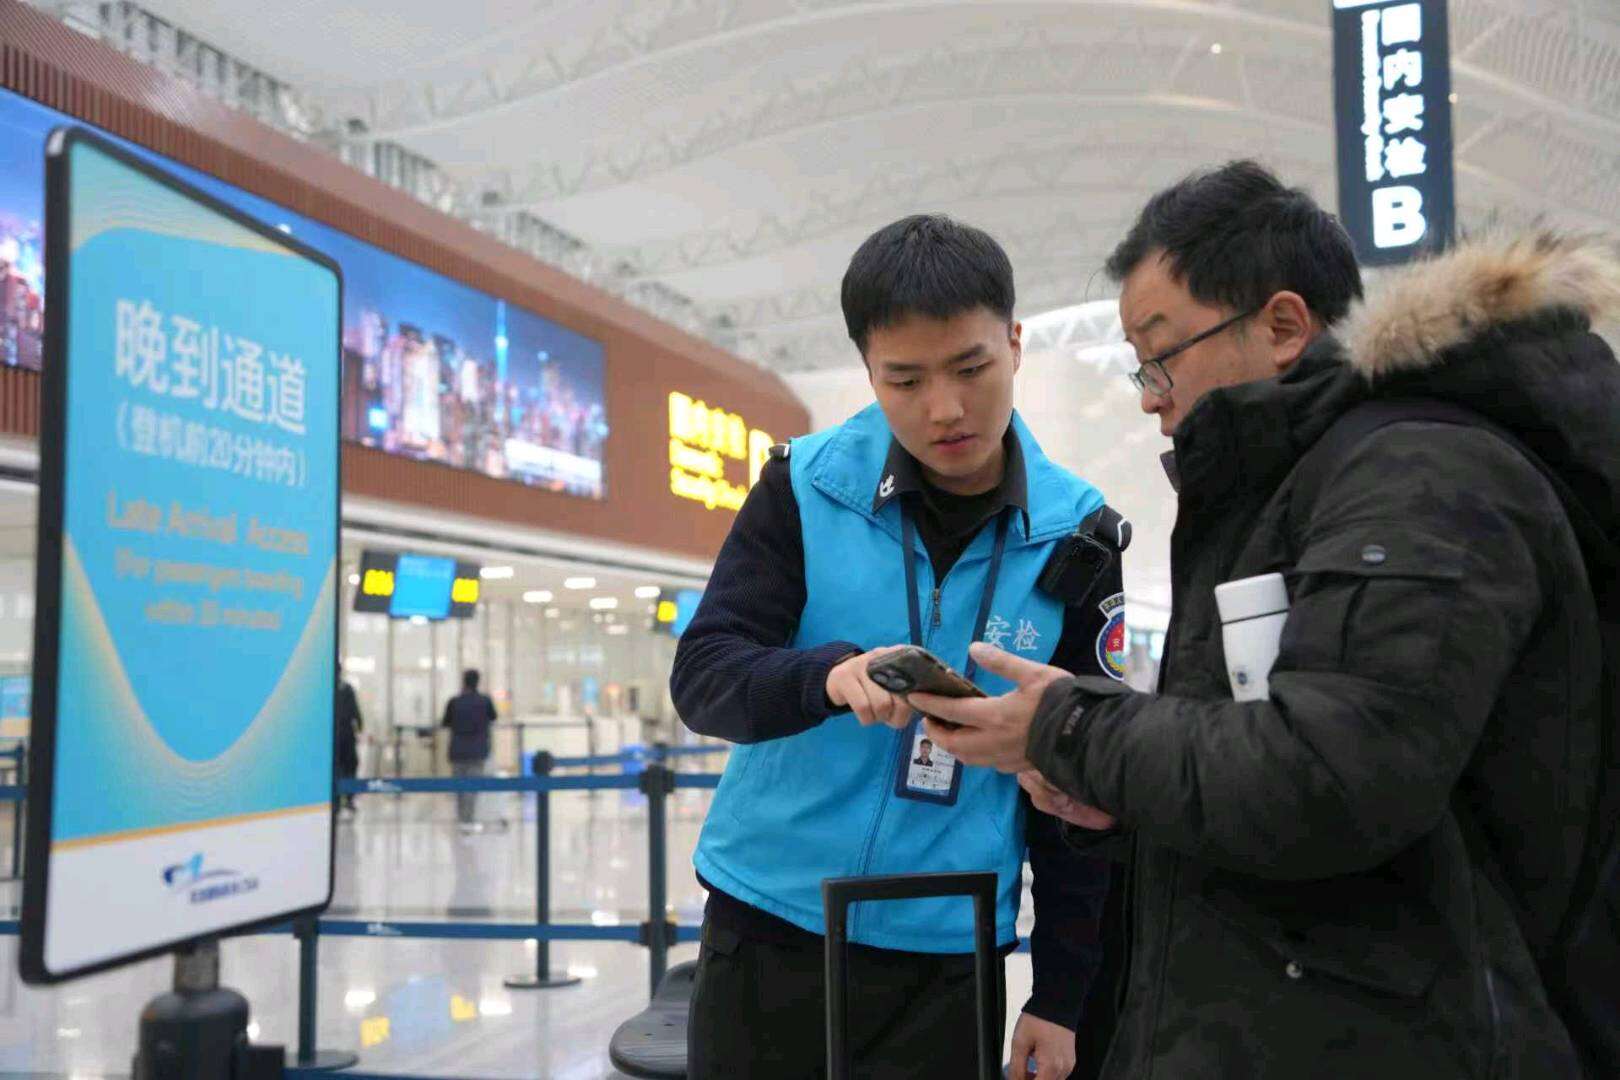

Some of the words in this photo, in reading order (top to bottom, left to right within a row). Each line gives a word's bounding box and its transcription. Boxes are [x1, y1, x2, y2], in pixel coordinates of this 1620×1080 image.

[1372, 186, 1426, 248] B
[115, 298, 307, 435] 晚到通道
[984, 615, 1042, 651] 安检
